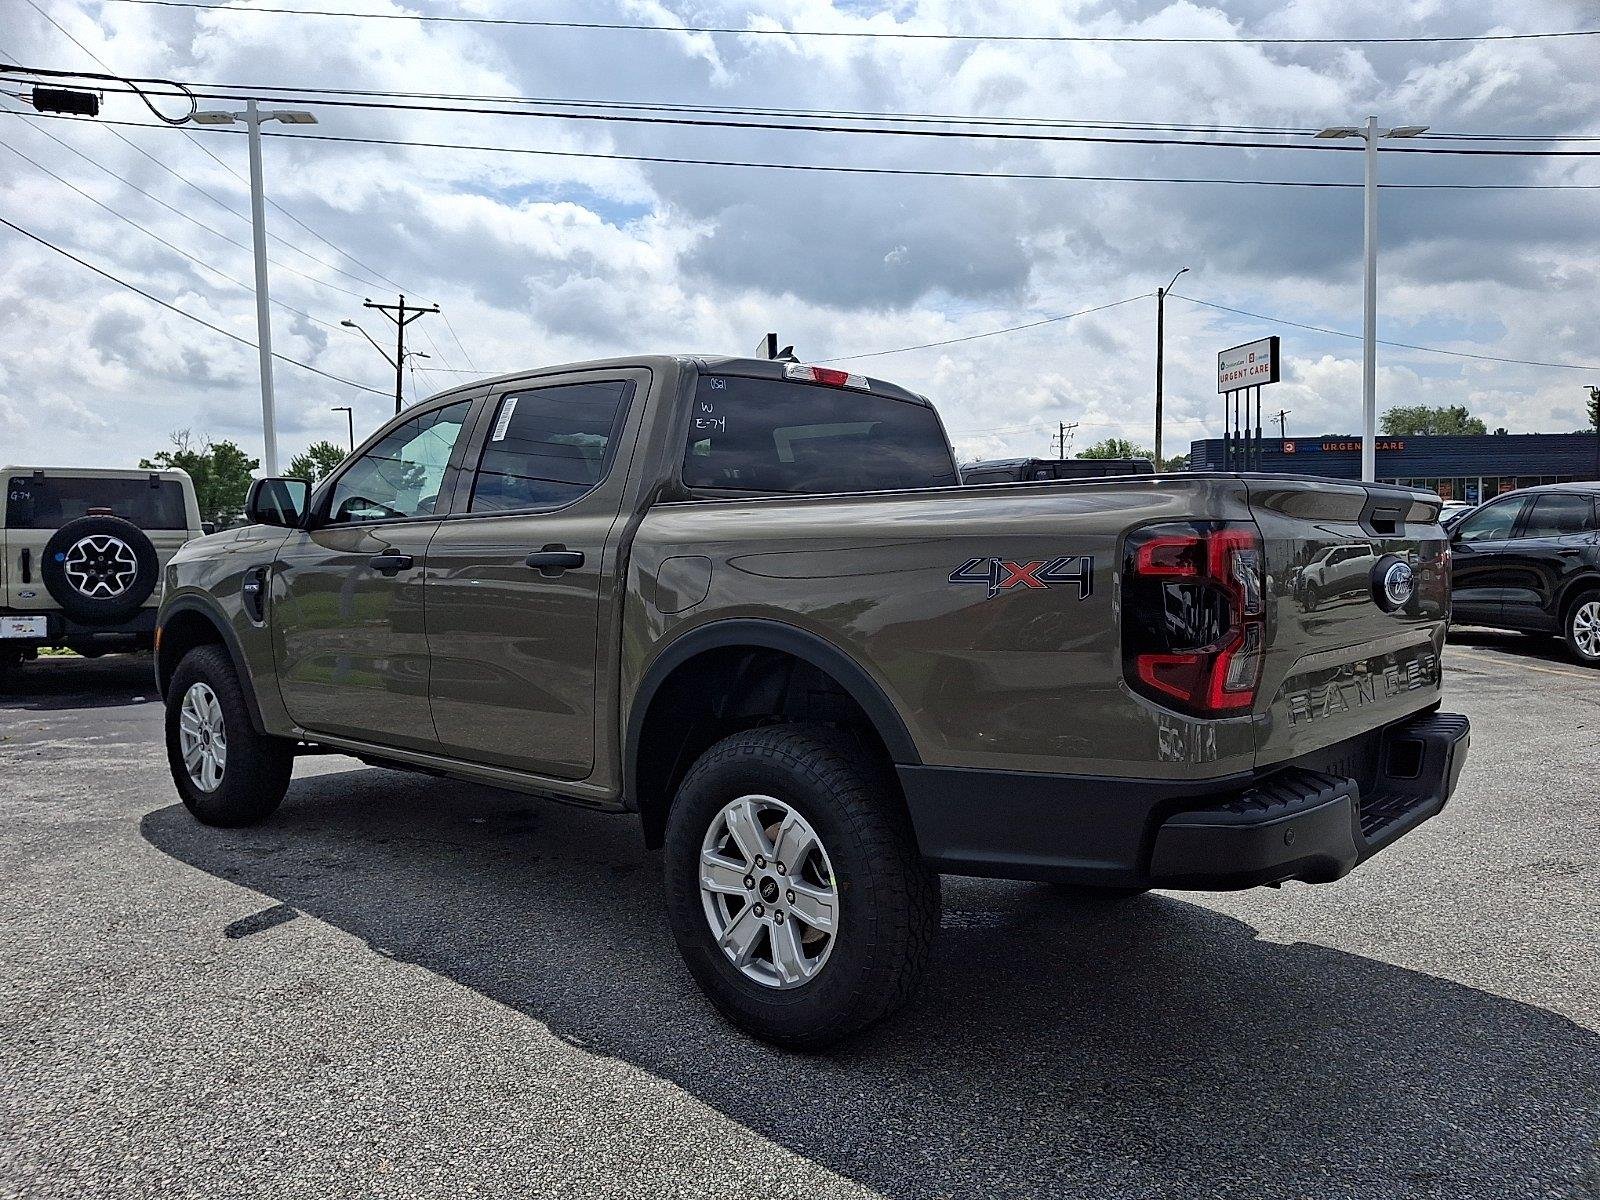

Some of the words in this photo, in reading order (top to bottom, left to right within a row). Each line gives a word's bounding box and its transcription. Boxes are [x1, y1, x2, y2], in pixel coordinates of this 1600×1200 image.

[1220, 368, 1248, 383] URGENT
[1249, 363, 1269, 376] CARE
[1322, 442, 1363, 451] URGEN
[1375, 442, 1405, 450] CARE
[1285, 653, 1437, 728] RANGER
